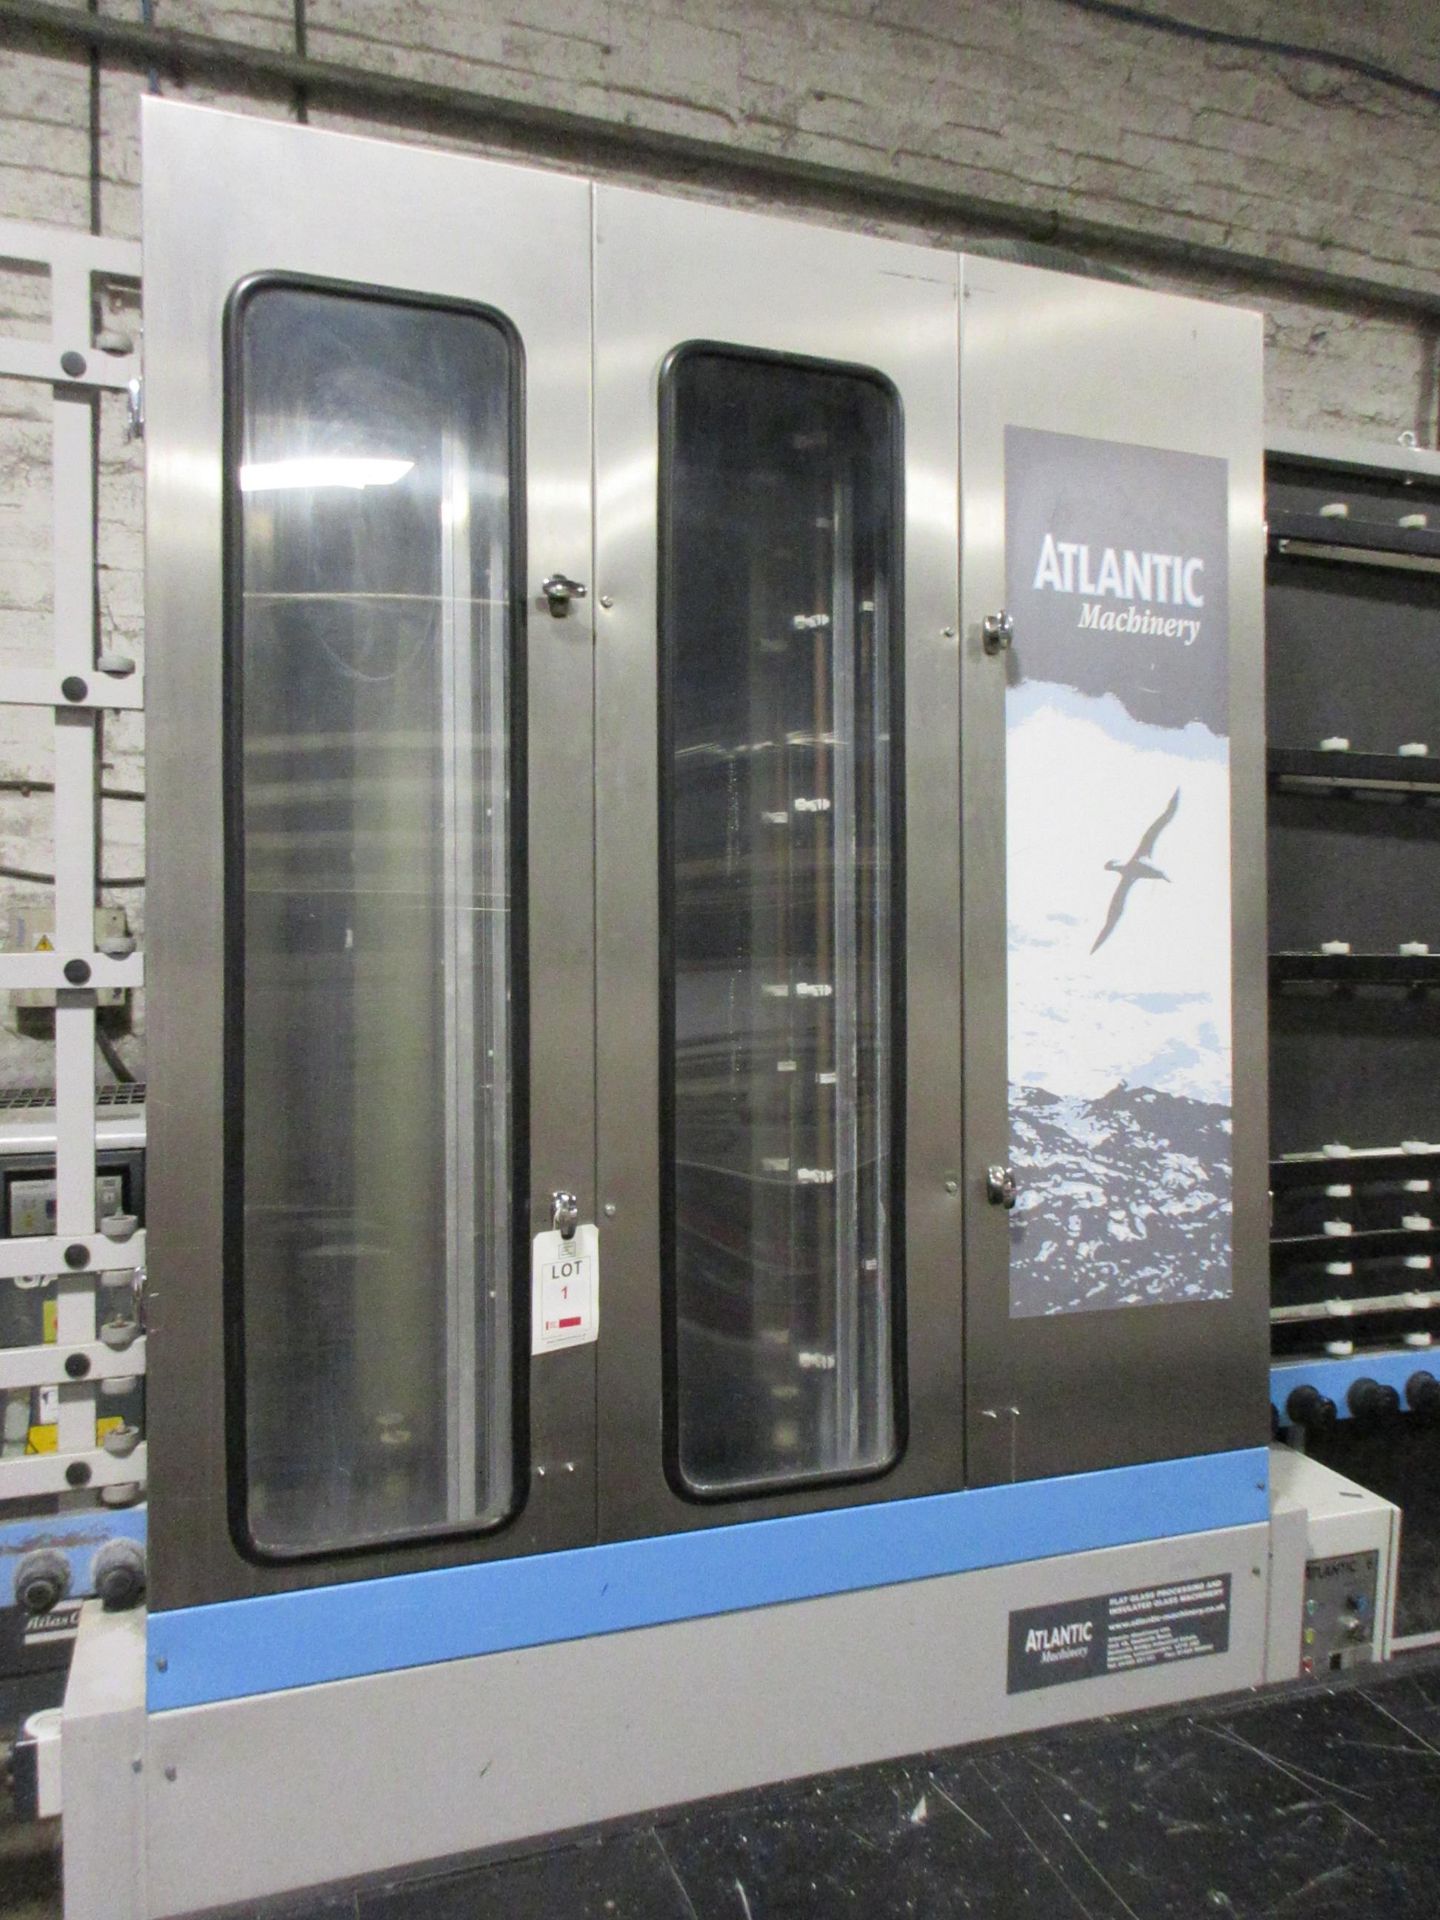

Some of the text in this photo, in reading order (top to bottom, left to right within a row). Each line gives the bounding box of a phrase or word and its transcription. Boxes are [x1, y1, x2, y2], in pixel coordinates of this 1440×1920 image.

[1033, 532, 1205, 608] ATLANTIC
[1077, 602, 1201, 646] Machinery
[551, 1261, 583, 1279] LOT
[561, 1285, 568, 1300] 1
[1025, 1621, 1094, 1653] ATLANTIC
[1040, 1645, 1089, 1664] Machinery
